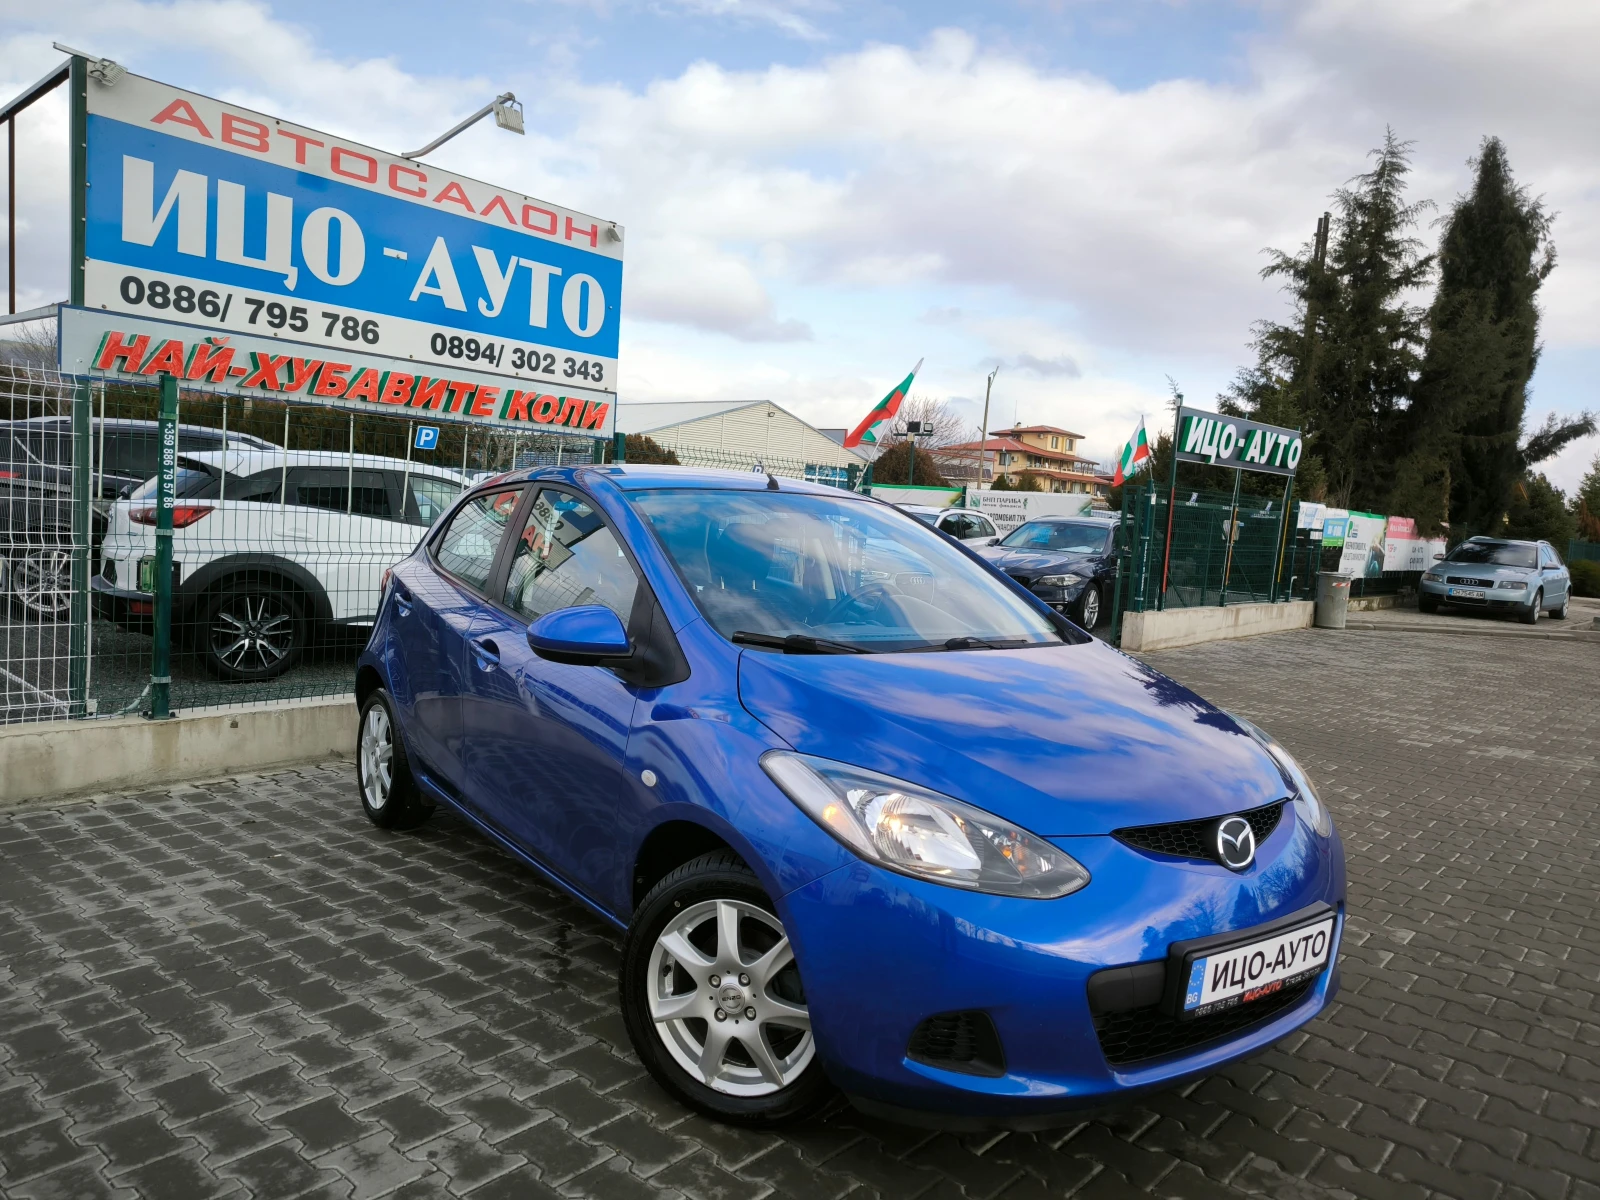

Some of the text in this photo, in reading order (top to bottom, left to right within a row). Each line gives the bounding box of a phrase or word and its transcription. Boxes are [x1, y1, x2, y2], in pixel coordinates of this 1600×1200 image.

[150, 98, 598, 248] АВТОСАЛОН
[119, 275, 380, 345] 0886/ 795 786
[92, 330, 610, 430] НАЙ-ХУБАВИТЕ КОЛИ
[511, 347, 556, 375] 302
[562, 357, 604, 382] 343
[163, 422, 175, 509] +359 886 79 57 86
[1211, 930, 1326, 993] ИЦО-АУТО
[721, 994, 741, 1002] ENZO
[1186, 992, 1198, 1004] BG
